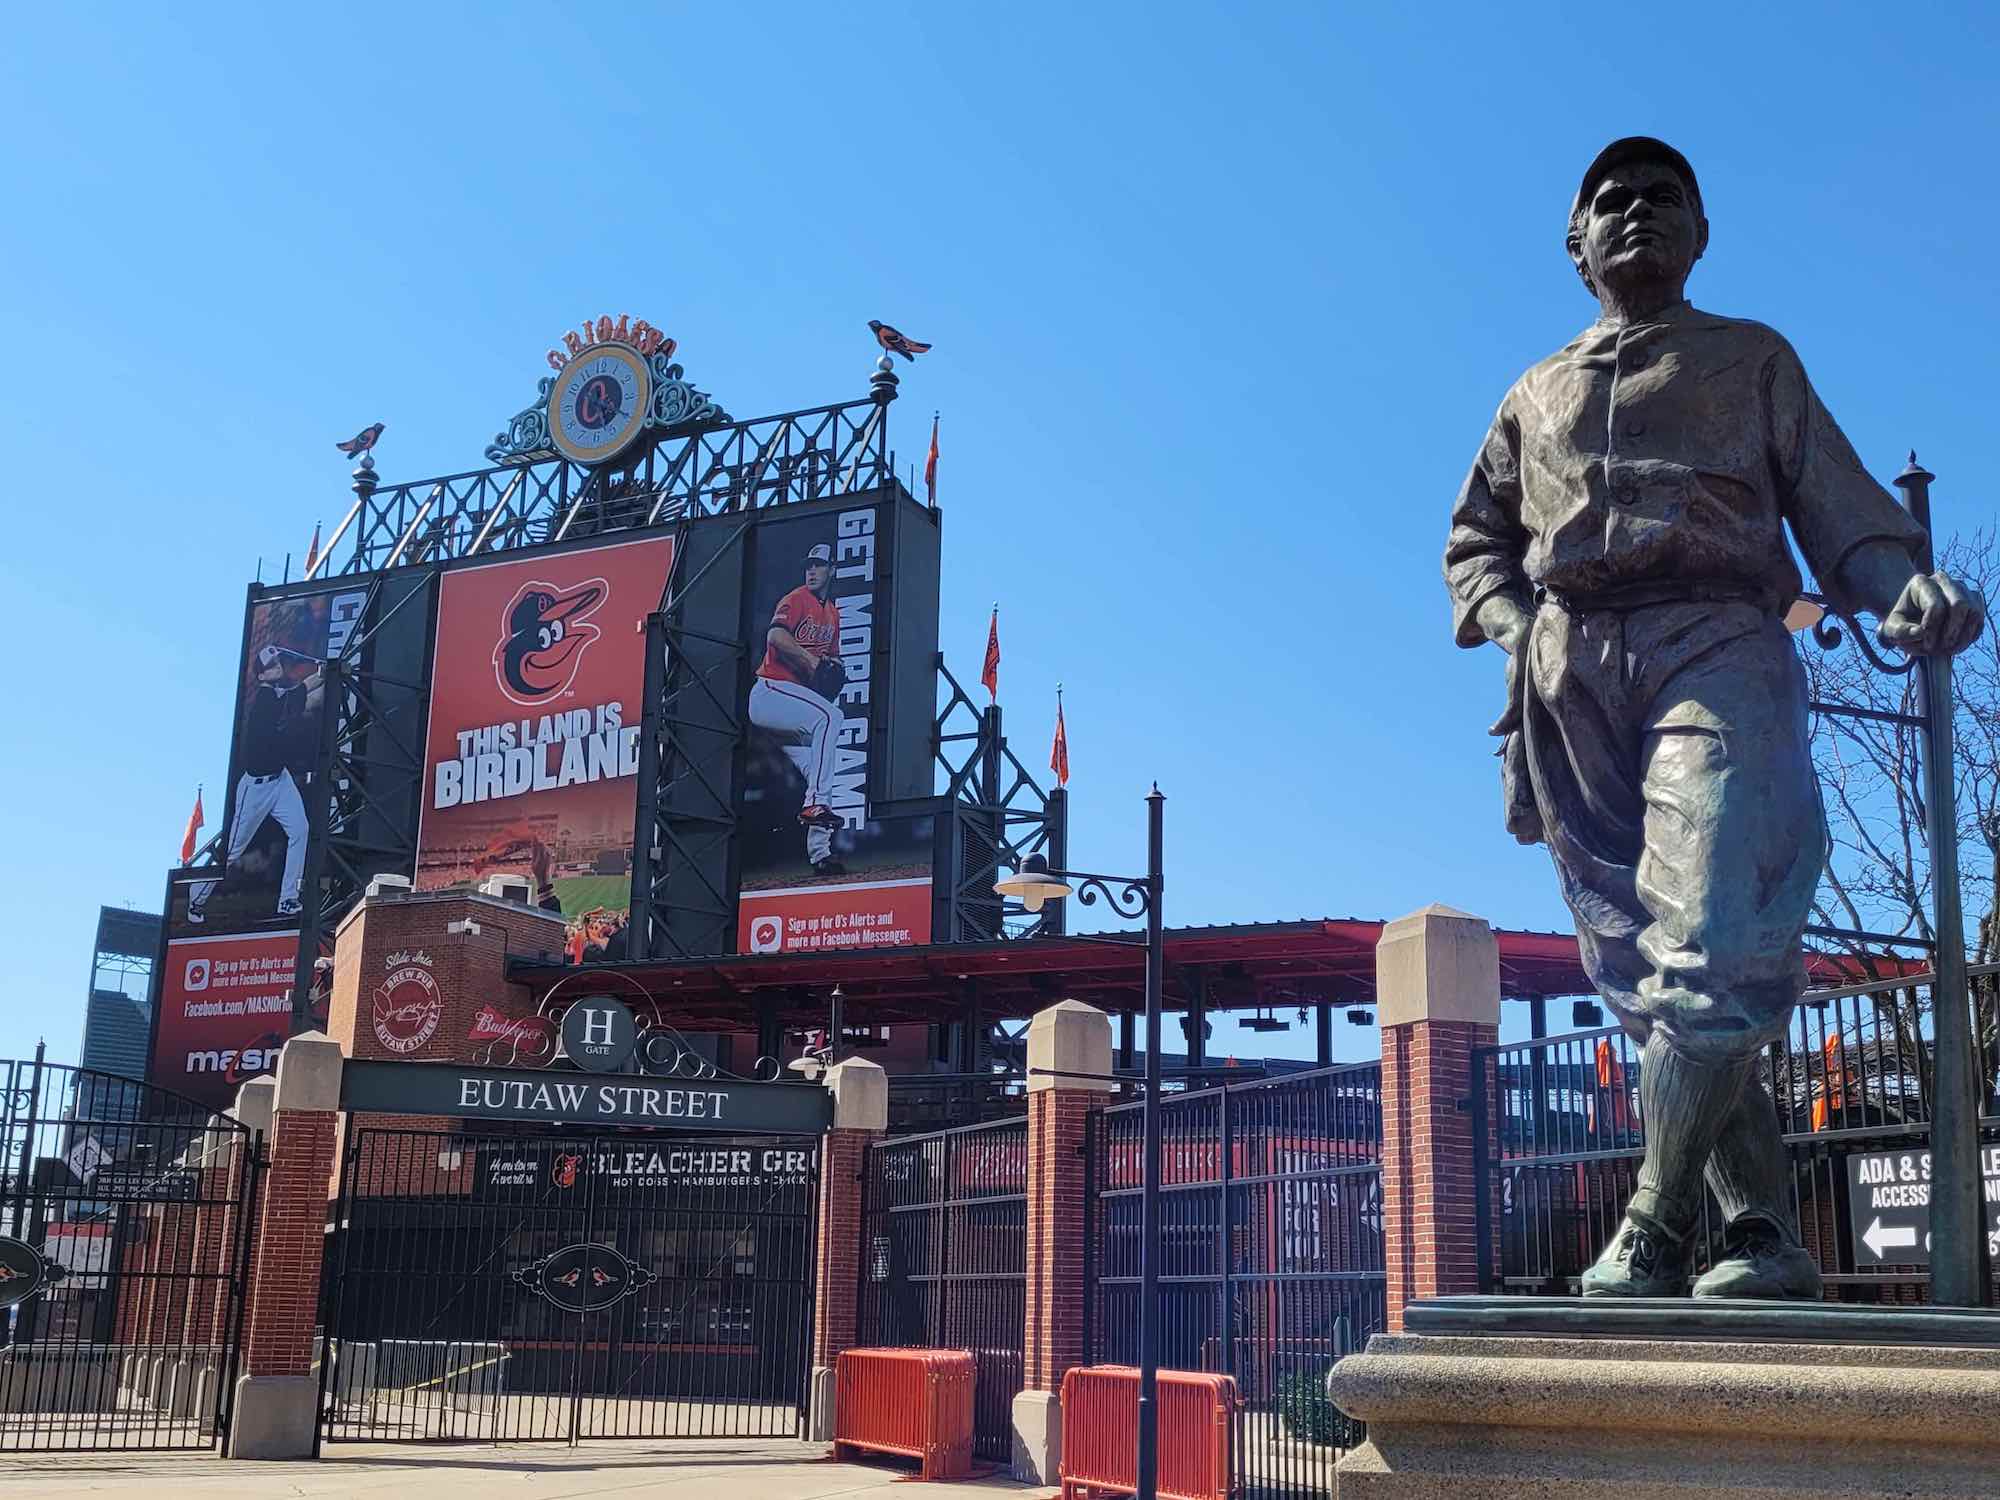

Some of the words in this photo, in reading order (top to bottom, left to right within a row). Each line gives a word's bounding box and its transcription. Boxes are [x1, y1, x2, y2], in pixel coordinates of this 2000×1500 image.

[836, 508, 875, 581] GET
[457, 722, 516, 760] THIS
[521, 708, 591, 747] LAND
[596, 702, 622, 733] IS
[434, 726, 641, 809] BIRDLAND
[787, 917, 806, 933] Sign
[808, 919, 818, 932] up
[821, 916, 833, 930] for
[849, 913, 875, 927] Alerts
[877, 911, 893, 925] and
[787, 936, 808, 948] more
[810, 936, 820, 947] on
[822, 932, 861, 946] Facebook
[862, 929, 911, 944] Messenger.
[214, 961, 228, 975] Sign
[230, 961, 238, 974] up
[261, 957, 281, 969] Alerts
[282, 956, 295, 967] and
[240, 973, 269, 985] Facebook
[386, 970, 415, 988] BREW
[416, 971, 433, 989] PUB
[376, 1023, 405, 1055] EUTAW
[407, 1012, 438, 1047] STREET
[475, 1011, 544, 1040] Budweiser
[579, 1008, 617, 1046] H
[585, 1046, 611, 1056] GATE
[457, 1078, 589, 1113] EUTAW
[598, 1085, 729, 1120] STREET
[588, 1150, 751, 1175] BLEACHER
[1858, 1157, 1896, 1184] ADA
[1900, 1155, 1917, 1181] &
[612, 1177, 632, 1187] HOT
[638, 1176, 669, 1187] DOGS
[682, 1175, 760, 1186] HAMBURGERS
[1871, 1184, 1931, 1208] ACCESS
